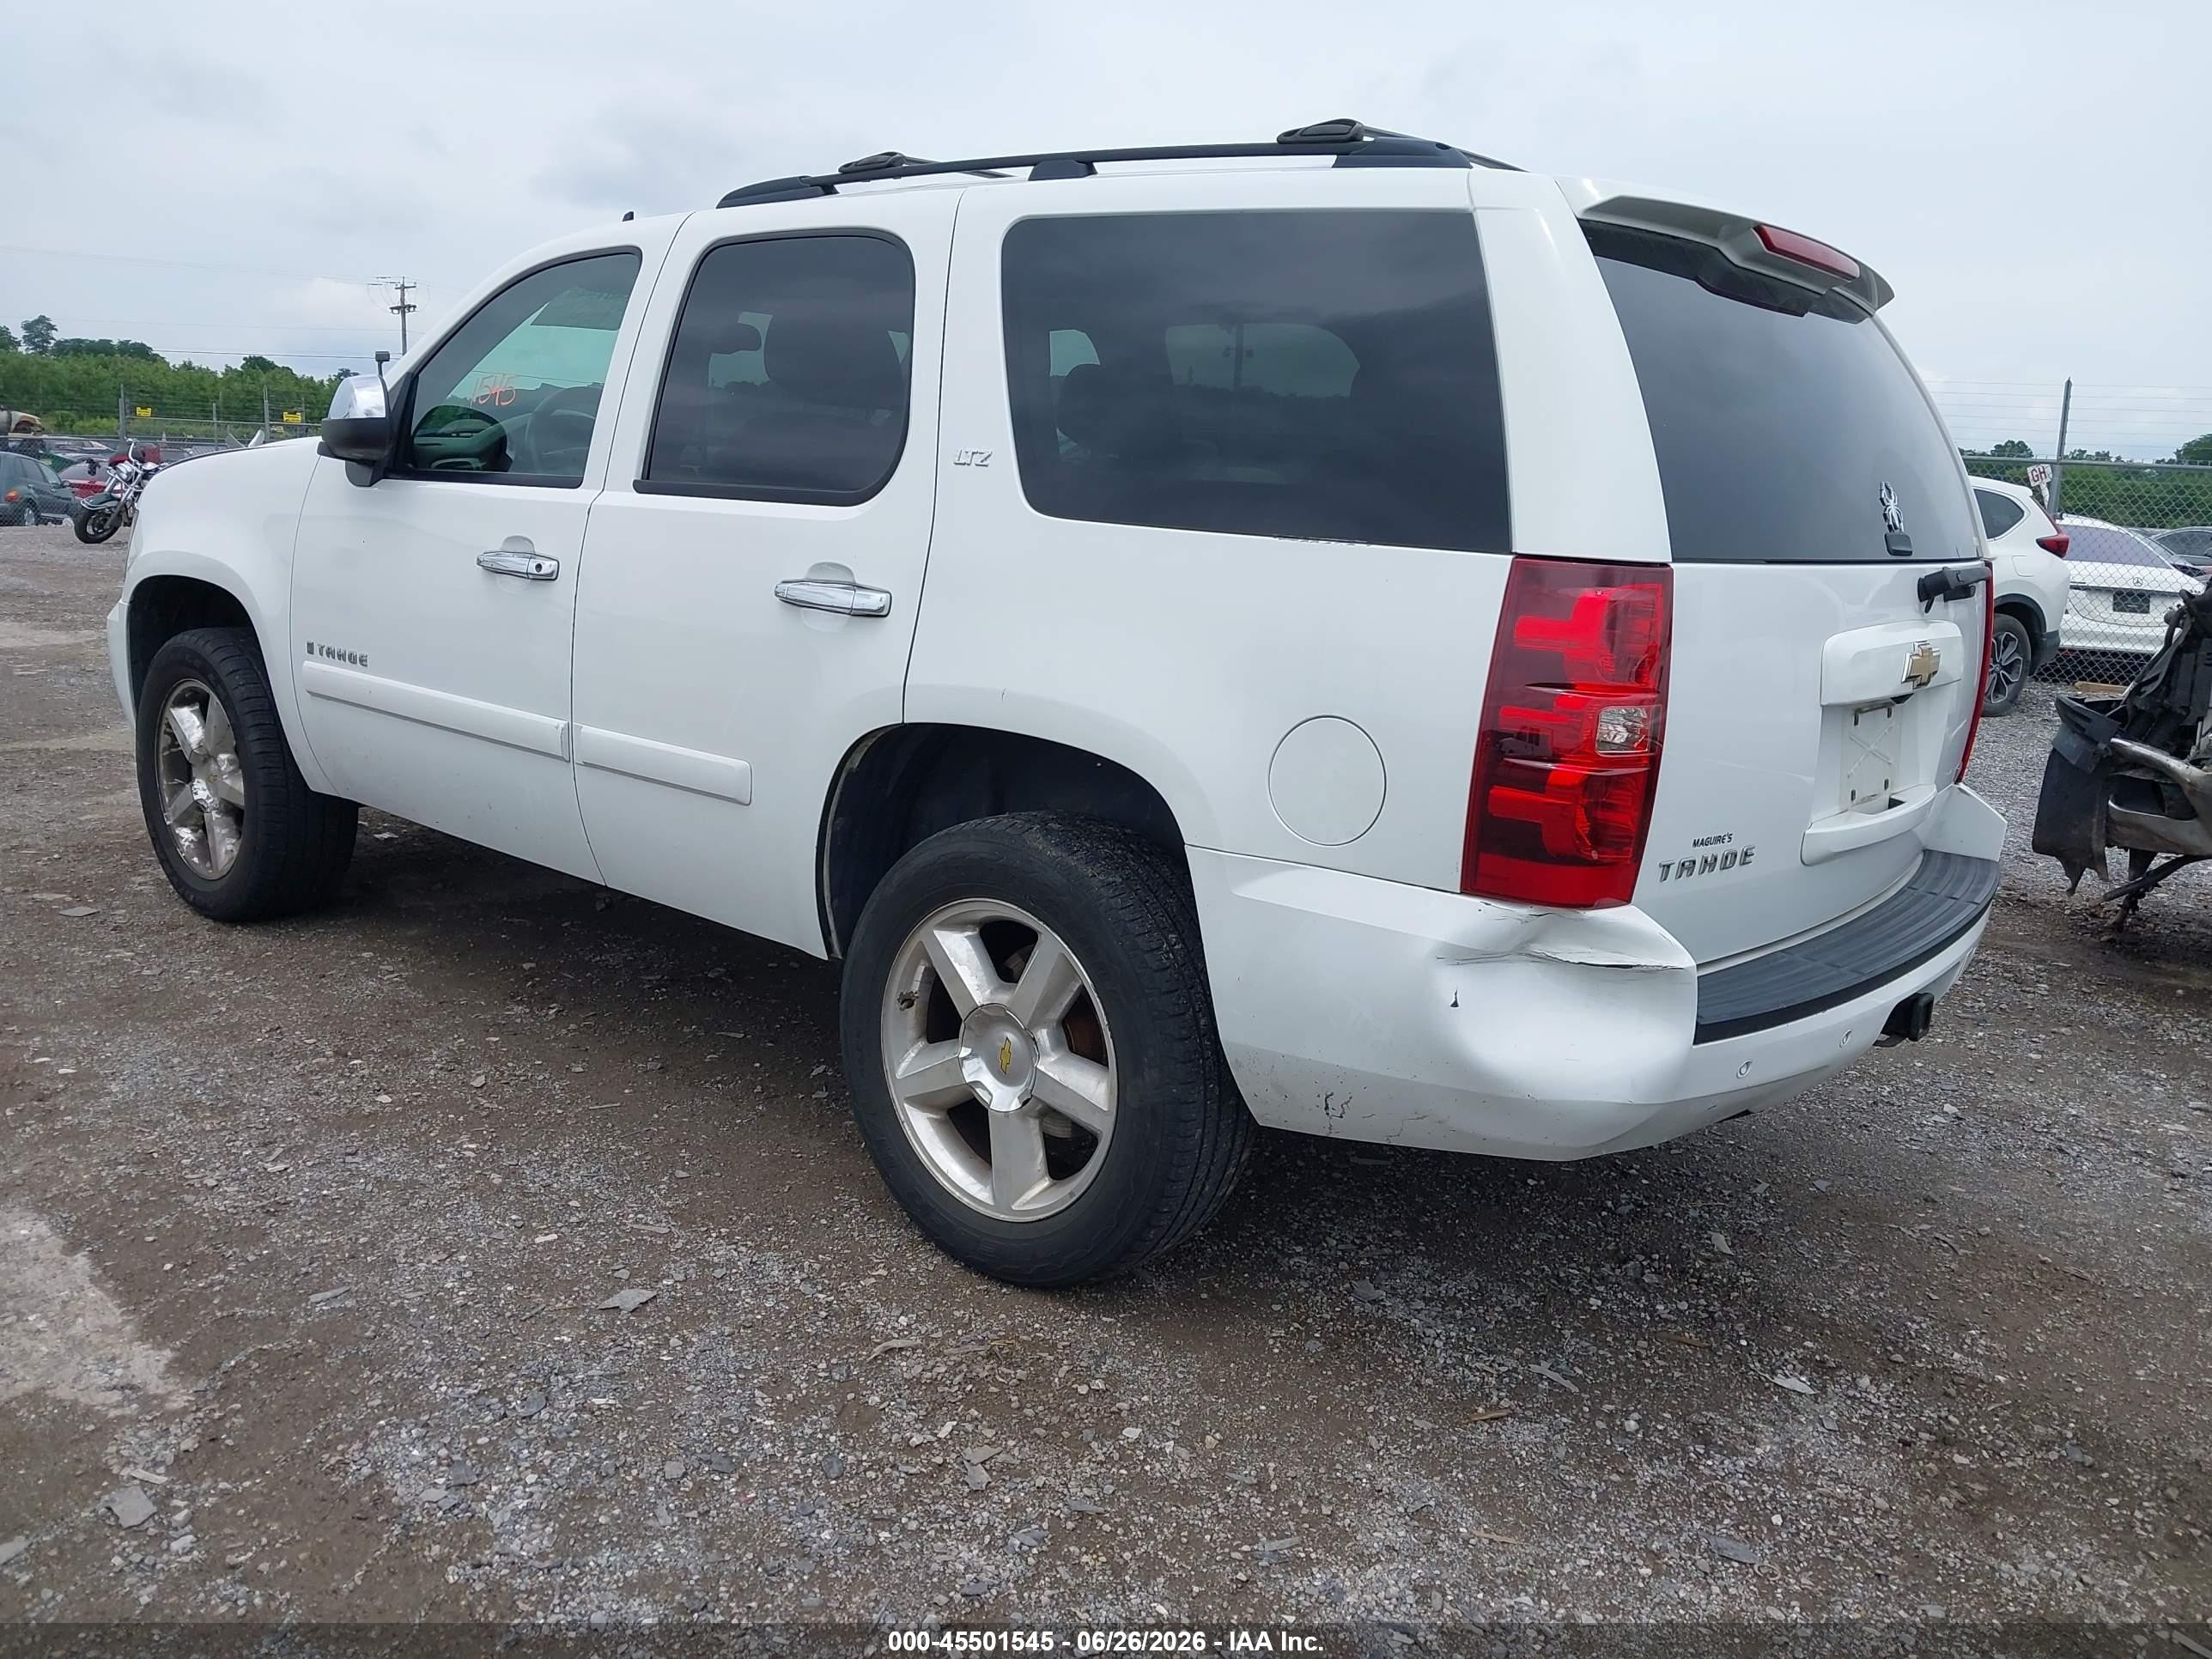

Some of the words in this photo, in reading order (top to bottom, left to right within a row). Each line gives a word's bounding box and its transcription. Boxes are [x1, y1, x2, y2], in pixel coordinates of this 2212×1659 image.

[953, 448, 994, 468] LTZ
[2031, 466, 2048, 483] GH
[317, 644, 368, 667] TAHOE
[1692, 831, 1734, 848] MAGUIRE'S
[1658, 844, 1756, 883] TAHOE
